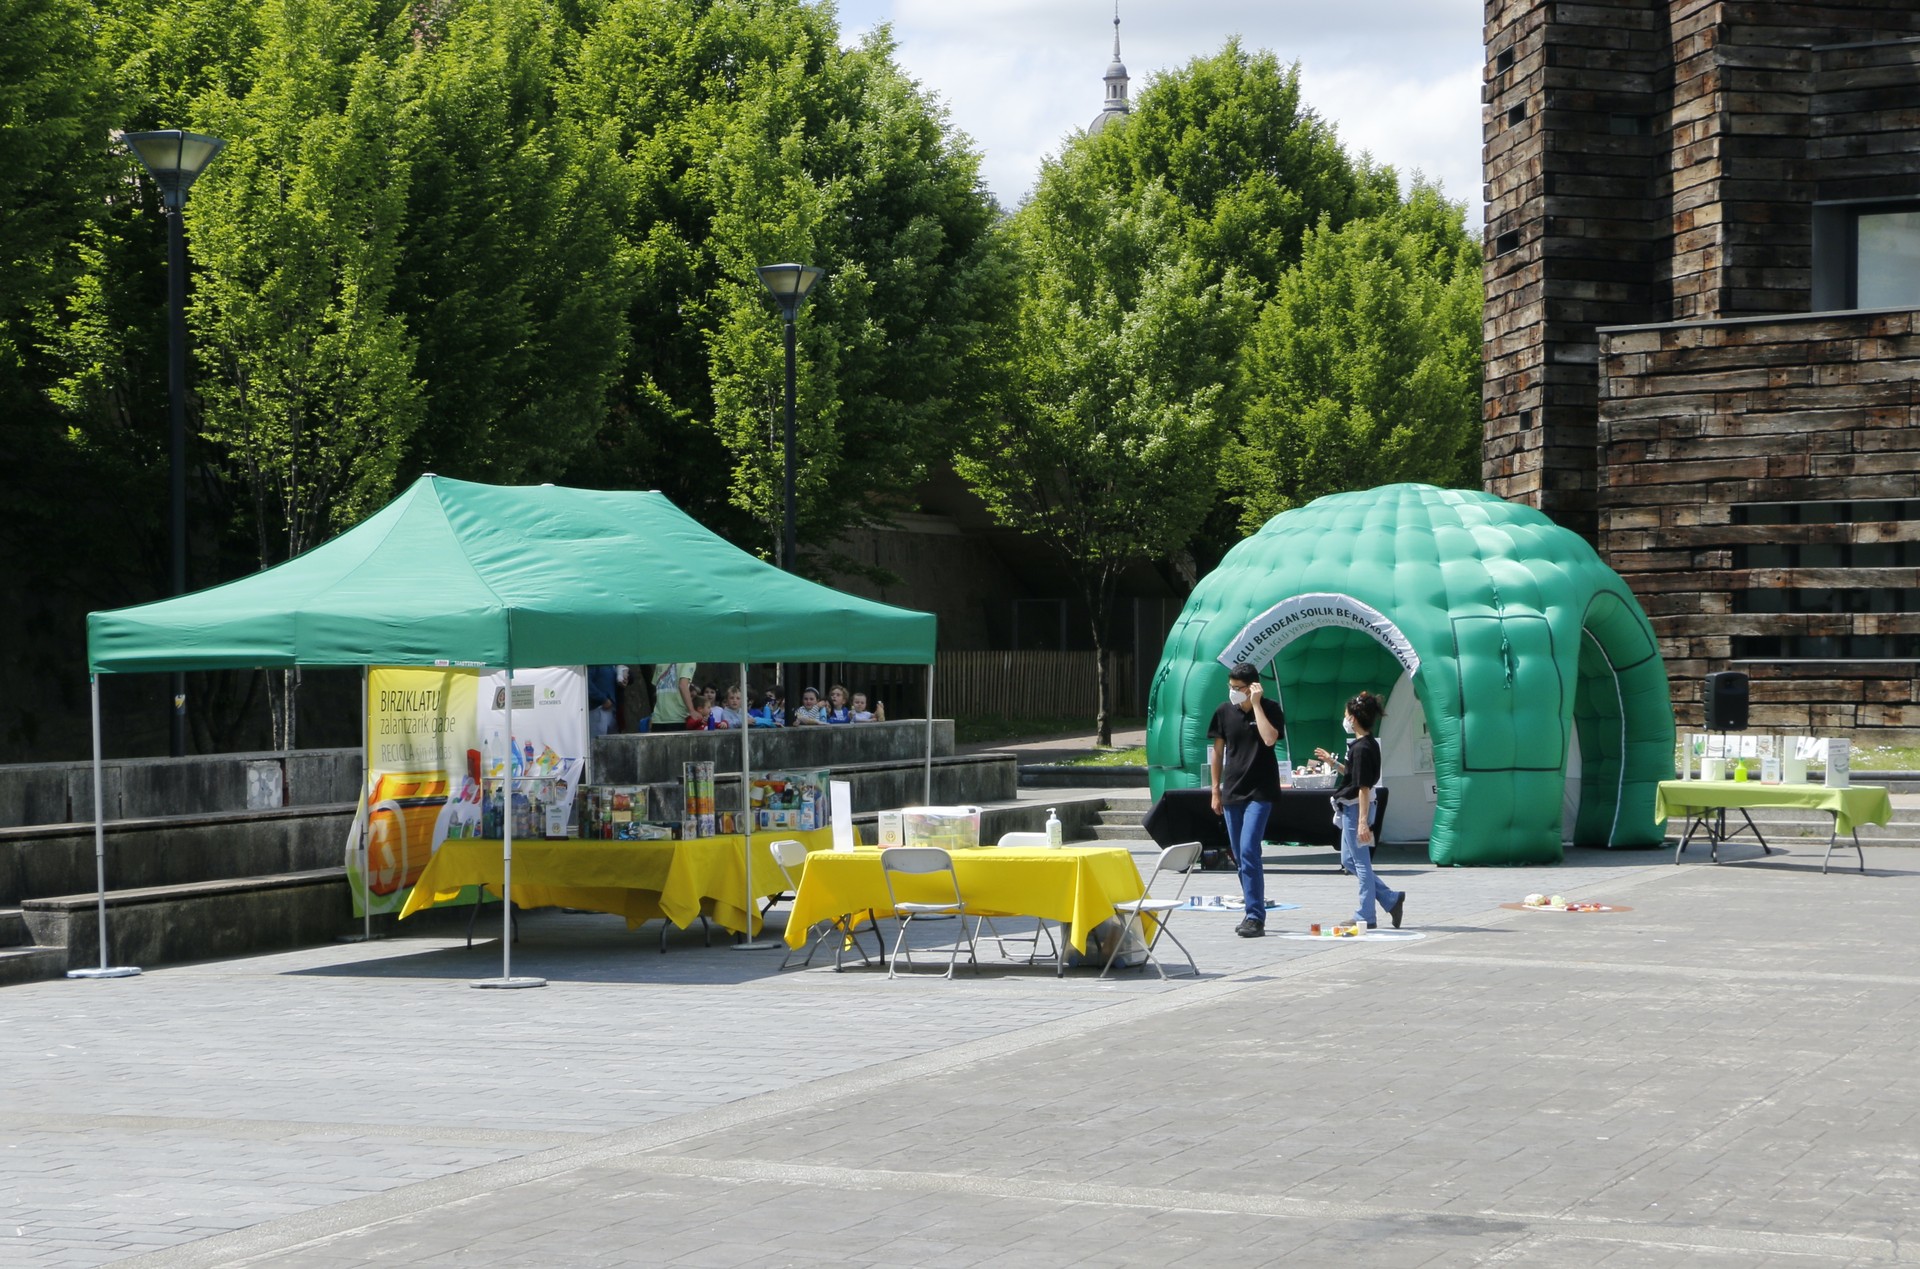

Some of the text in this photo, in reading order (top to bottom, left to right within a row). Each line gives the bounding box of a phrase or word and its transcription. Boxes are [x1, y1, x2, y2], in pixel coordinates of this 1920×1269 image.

[1233, 642, 1255, 665] IGLU
[1253, 612, 1300, 645] BERDEAN
[1300, 607, 1334, 619] SOILIK
[1336, 608, 1382, 635] BERAZKO
[1260, 647, 1271, 657] EL
[1289, 620, 1316, 636] VERDE
[381, 690, 441, 712] BIRZIKLATU
[380, 711, 456, 739] zalantzarik gabe
[381, 743, 415, 762] RECICLA
[416, 744, 428, 761] sin
